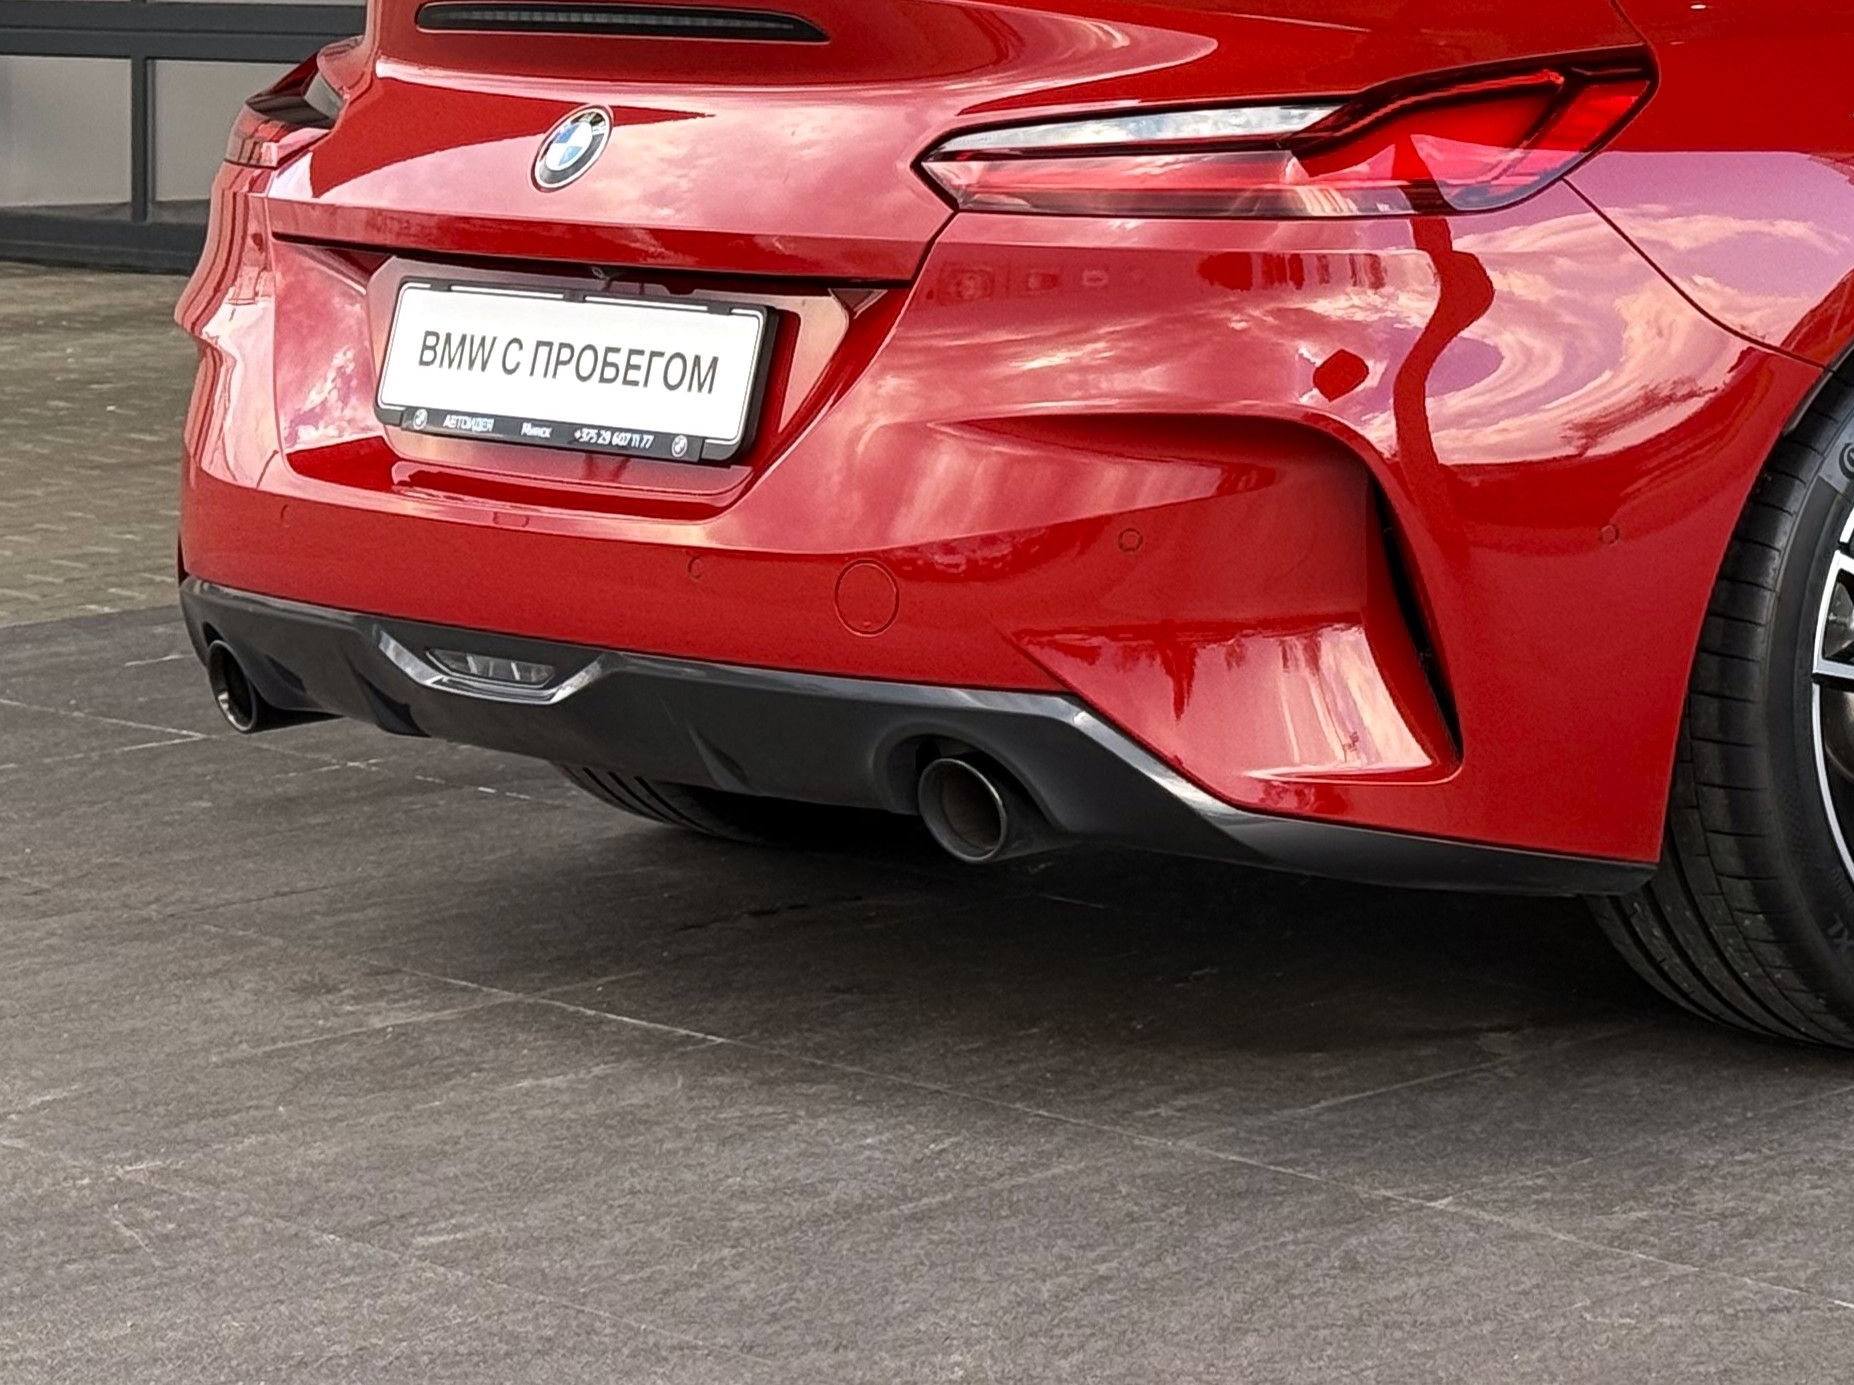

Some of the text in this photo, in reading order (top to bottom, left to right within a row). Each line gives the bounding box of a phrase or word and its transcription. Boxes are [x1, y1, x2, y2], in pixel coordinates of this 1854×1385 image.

[419, 330, 719, 394] BMW С ПРОБЕГОМ
